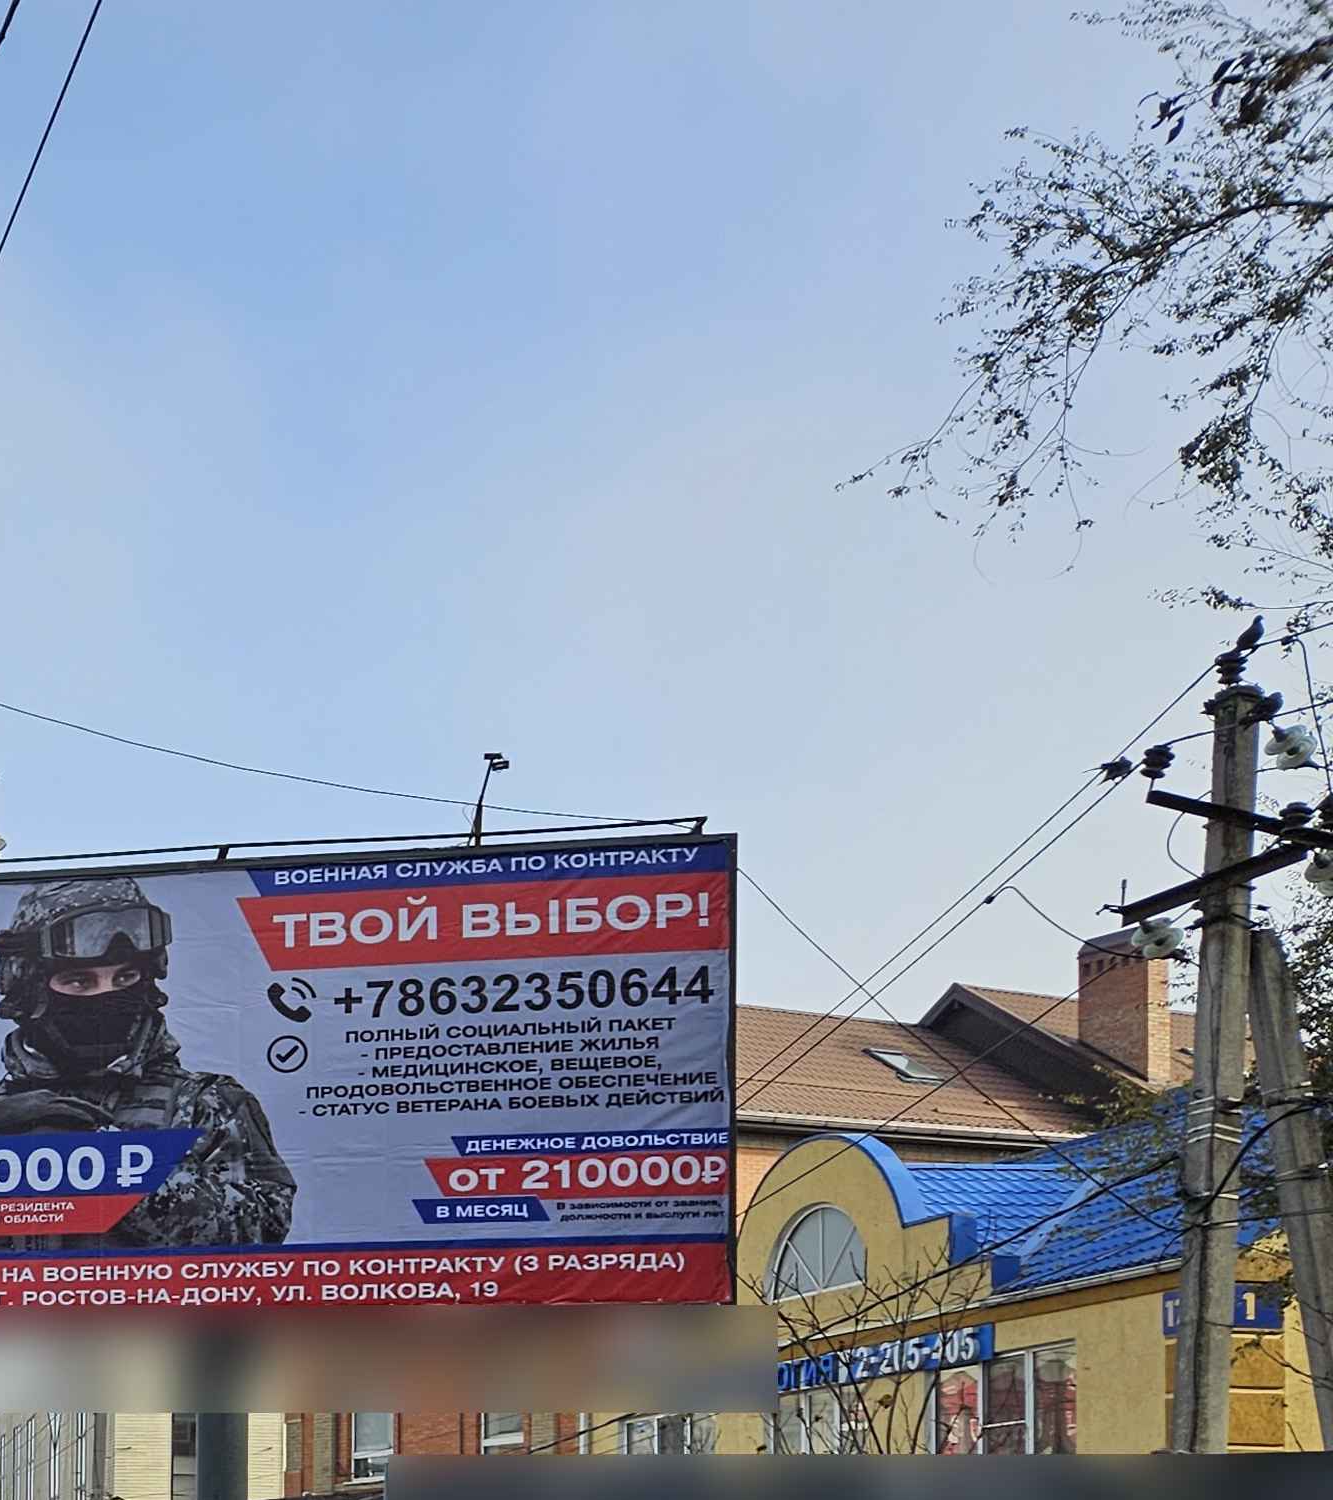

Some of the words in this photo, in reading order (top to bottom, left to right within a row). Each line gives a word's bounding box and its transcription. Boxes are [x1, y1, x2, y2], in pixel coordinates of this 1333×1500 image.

[274, 864, 388, 885] ВОЕННАЯ
[395, 858, 503, 881] СЛУЖБА
[510, 855, 546, 873] ПО
[554, 847, 699, 871] КОНТРАКТУ
[273, 895, 437, 948] ТВОЙ
[461, 892, 710, 938] ВЫБОР!
[334, 965, 714, 1018] +78632350644
[345, 1024, 440, 1043] ПОЛНЫЙ
[446, 1017, 601, 1040] СОЦИАЛЬНЫЙ
[608, 1017, 676, 1032] ПАКЕТ
[375, 1040, 573, 1061] ПРЕДОСТАВЛЕНИЕ
[580, 1036, 659, 1052] ЖИЛЬЯ
[372, 1060, 543, 1079] МЕДИЦИНСКОЕ,
[550, 1055, 662, 1073] ВЕЩЕВОЕ,
[307, 1077, 551, 1100] ПРОДОВОЛЬСТВЕННОЕ
[558, 1071, 718, 1090] ОБЕСПЕЧЕНИЕ
[312, 1100, 390, 1117] СТАТУС
[396, 1098, 503, 1114] ВЕТЕРАНА
[508, 1094, 600, 1110] БОЕВЫХ
[605, 1086, 724, 1108] ДЕЙСТВИЙ
[465, 1137, 576, 1154] ДЕНЕЖНОЕ
[581, 1132, 728, 1150] ДОВОЛЬСТВИЕ
[4, 1213, 64, 1223] ОБЛАСТИ
[437, 1206, 450, 1218] В
[456, 1203, 529, 1218] МЕСЯЦ
[560, 1212, 633, 1222] должности
[568, 1200, 653, 1211] зависимости
[655, 1201, 670, 1209] от
[2, 1267, 36, 1283] НА
[43, 1263, 174, 1282] ВОЕННУЮ
[181, 1260, 294, 1279] СЛУЖБУ
[303, 1261, 341, 1277] ПО
[349, 1256, 506, 1275] КОНТРАКТУ
[514, 1254, 539, 1276] (3
[547, 1251, 686, 1273] РАЗРЯДА)
[23, 1286, 262, 1306] РОСТОВ-НА-ДОНУ,
[271, 1285, 312, 1301] УЛ.
[321, 1282, 461, 1301] ВОЛКОВА,
[469, 1281, 499, 1298] 19
